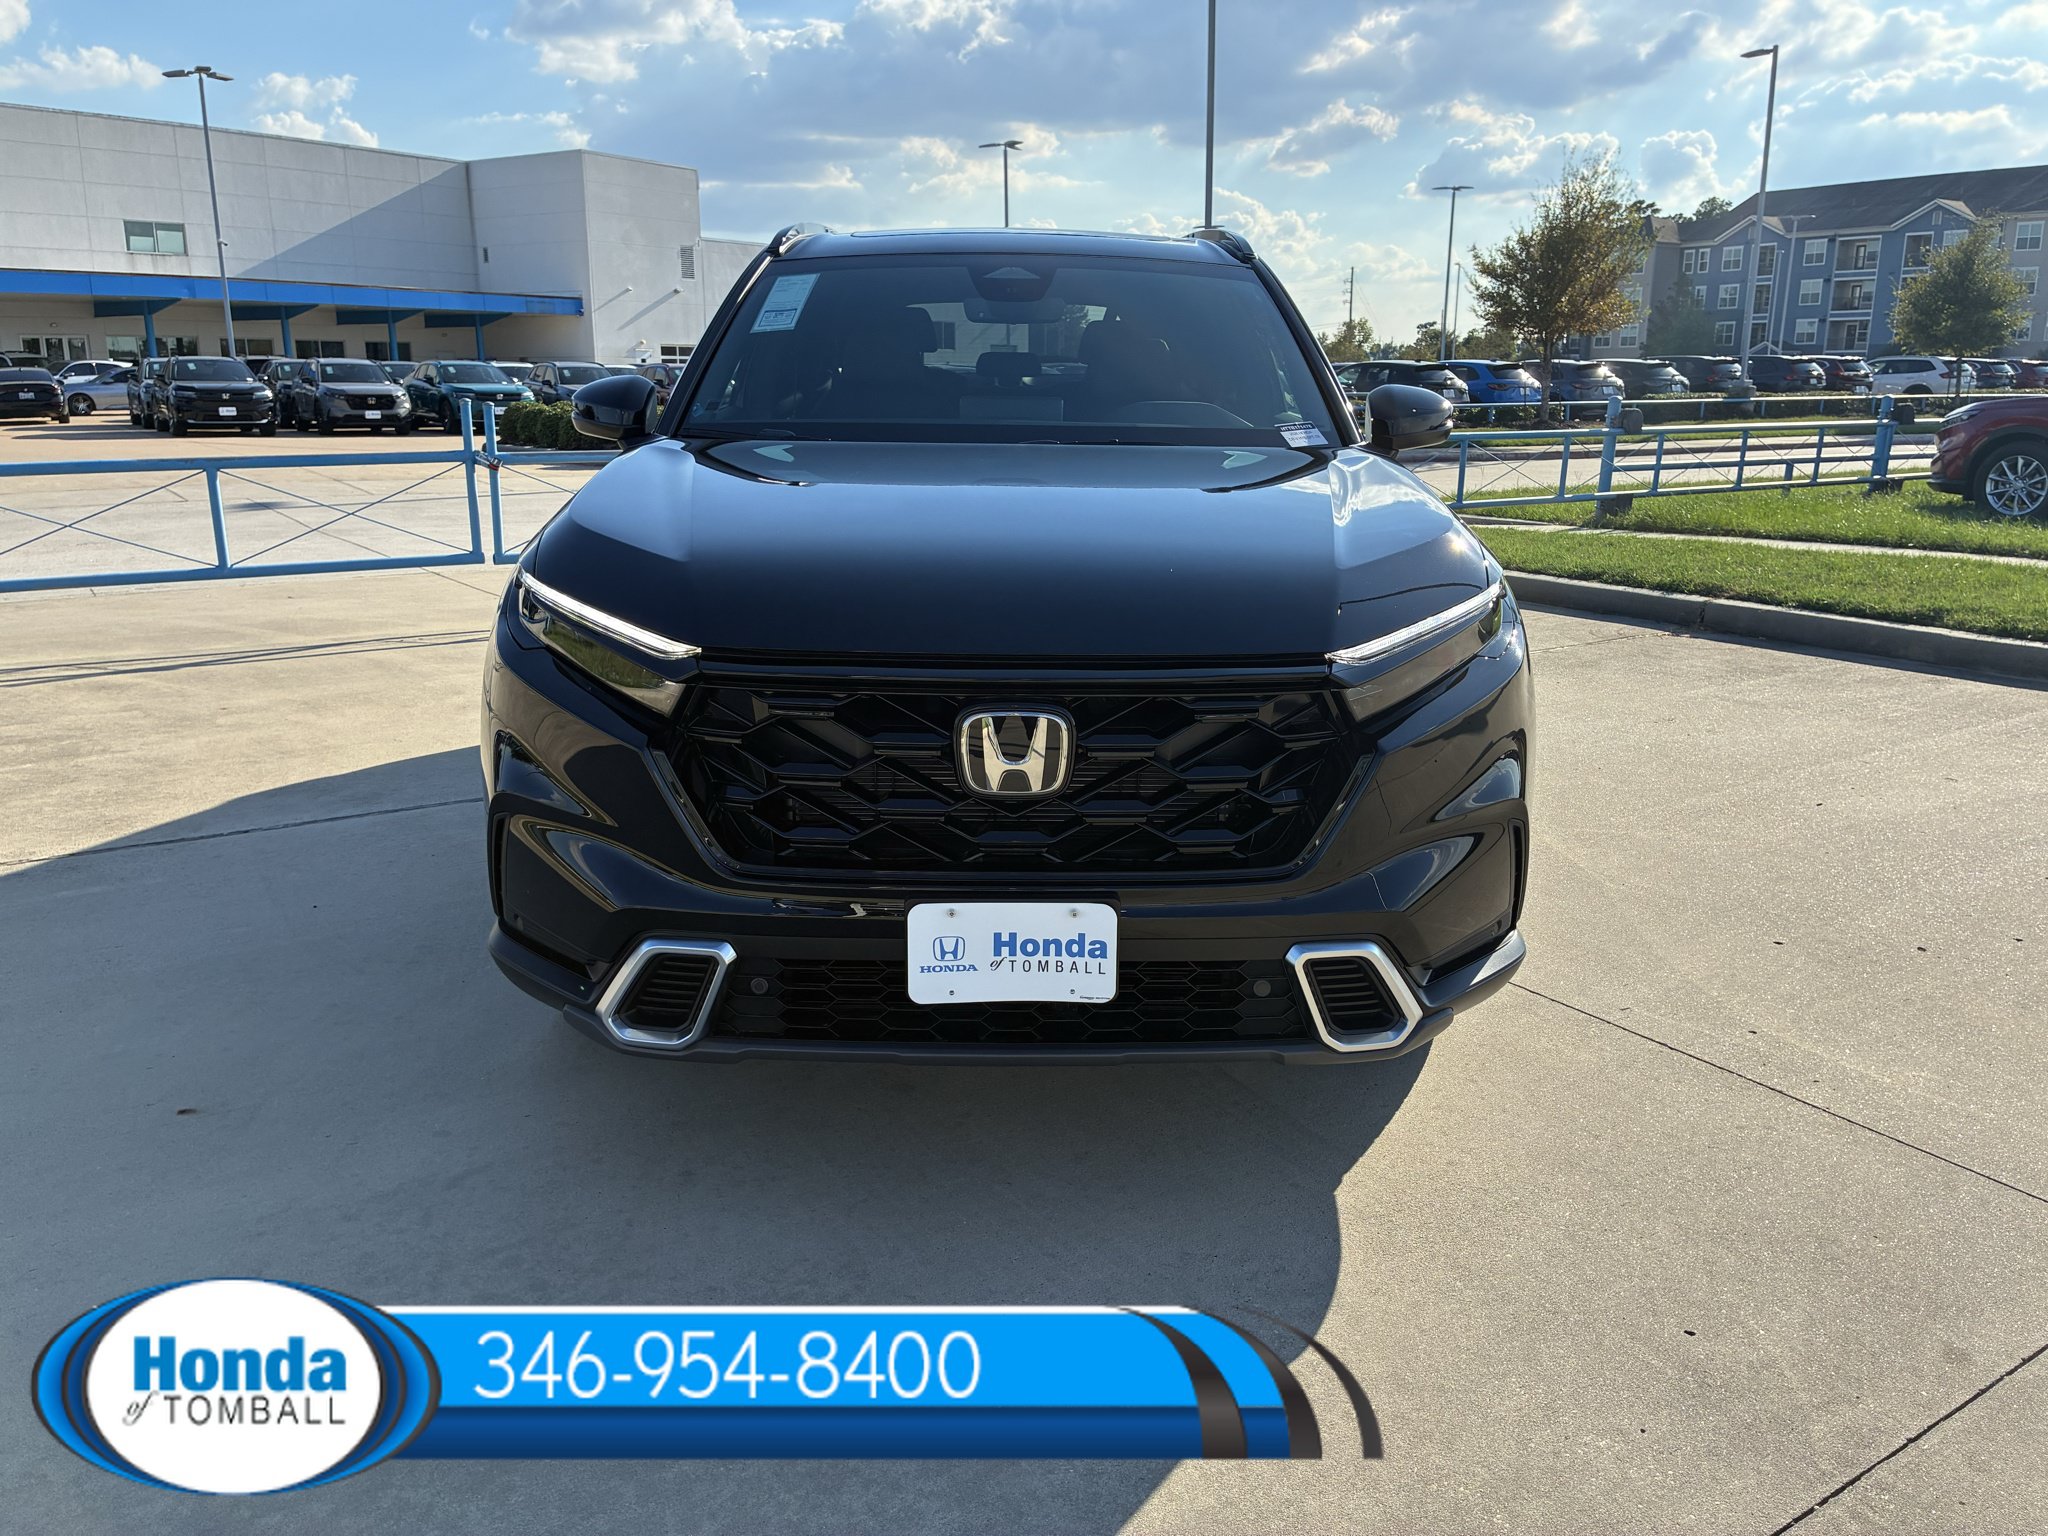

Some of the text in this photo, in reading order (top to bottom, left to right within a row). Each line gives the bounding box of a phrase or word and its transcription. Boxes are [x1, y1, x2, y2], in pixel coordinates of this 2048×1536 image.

[993, 932, 1107, 959] Honda
[920, 964, 978, 974] HONDA
[990, 957, 1106, 975] of TOMBALL
